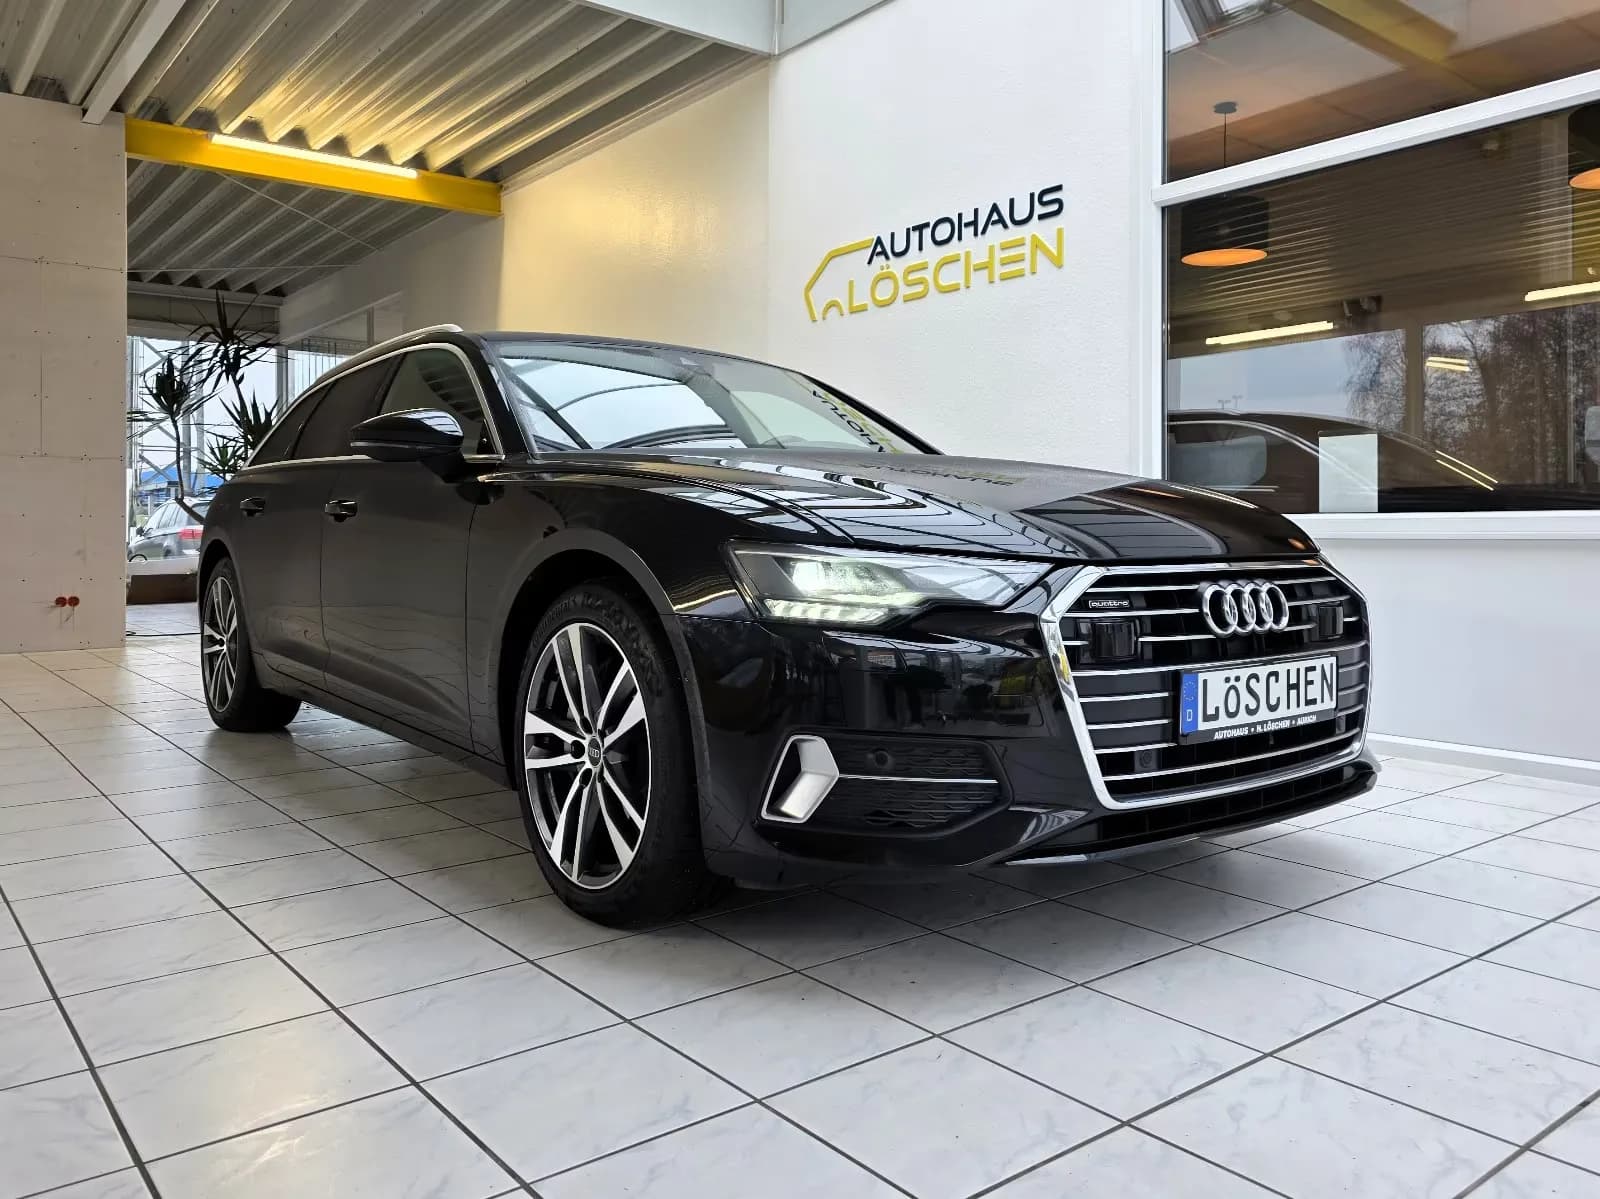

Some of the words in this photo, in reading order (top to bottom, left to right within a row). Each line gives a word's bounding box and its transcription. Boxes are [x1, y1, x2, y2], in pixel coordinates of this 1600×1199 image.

[867, 184, 1064, 265] AUTOHAUS
[848, 227, 1064, 313] LÖSCHEN
[1090, 600, 1129, 608] quattro
[1202, 662, 1334, 722] LÖSCHEN
[1186, 709, 1193, 722] D
[1213, 727, 1249, 740] AUTOHAUS
[1263, 719, 1291, 731] LÖSCHEN
